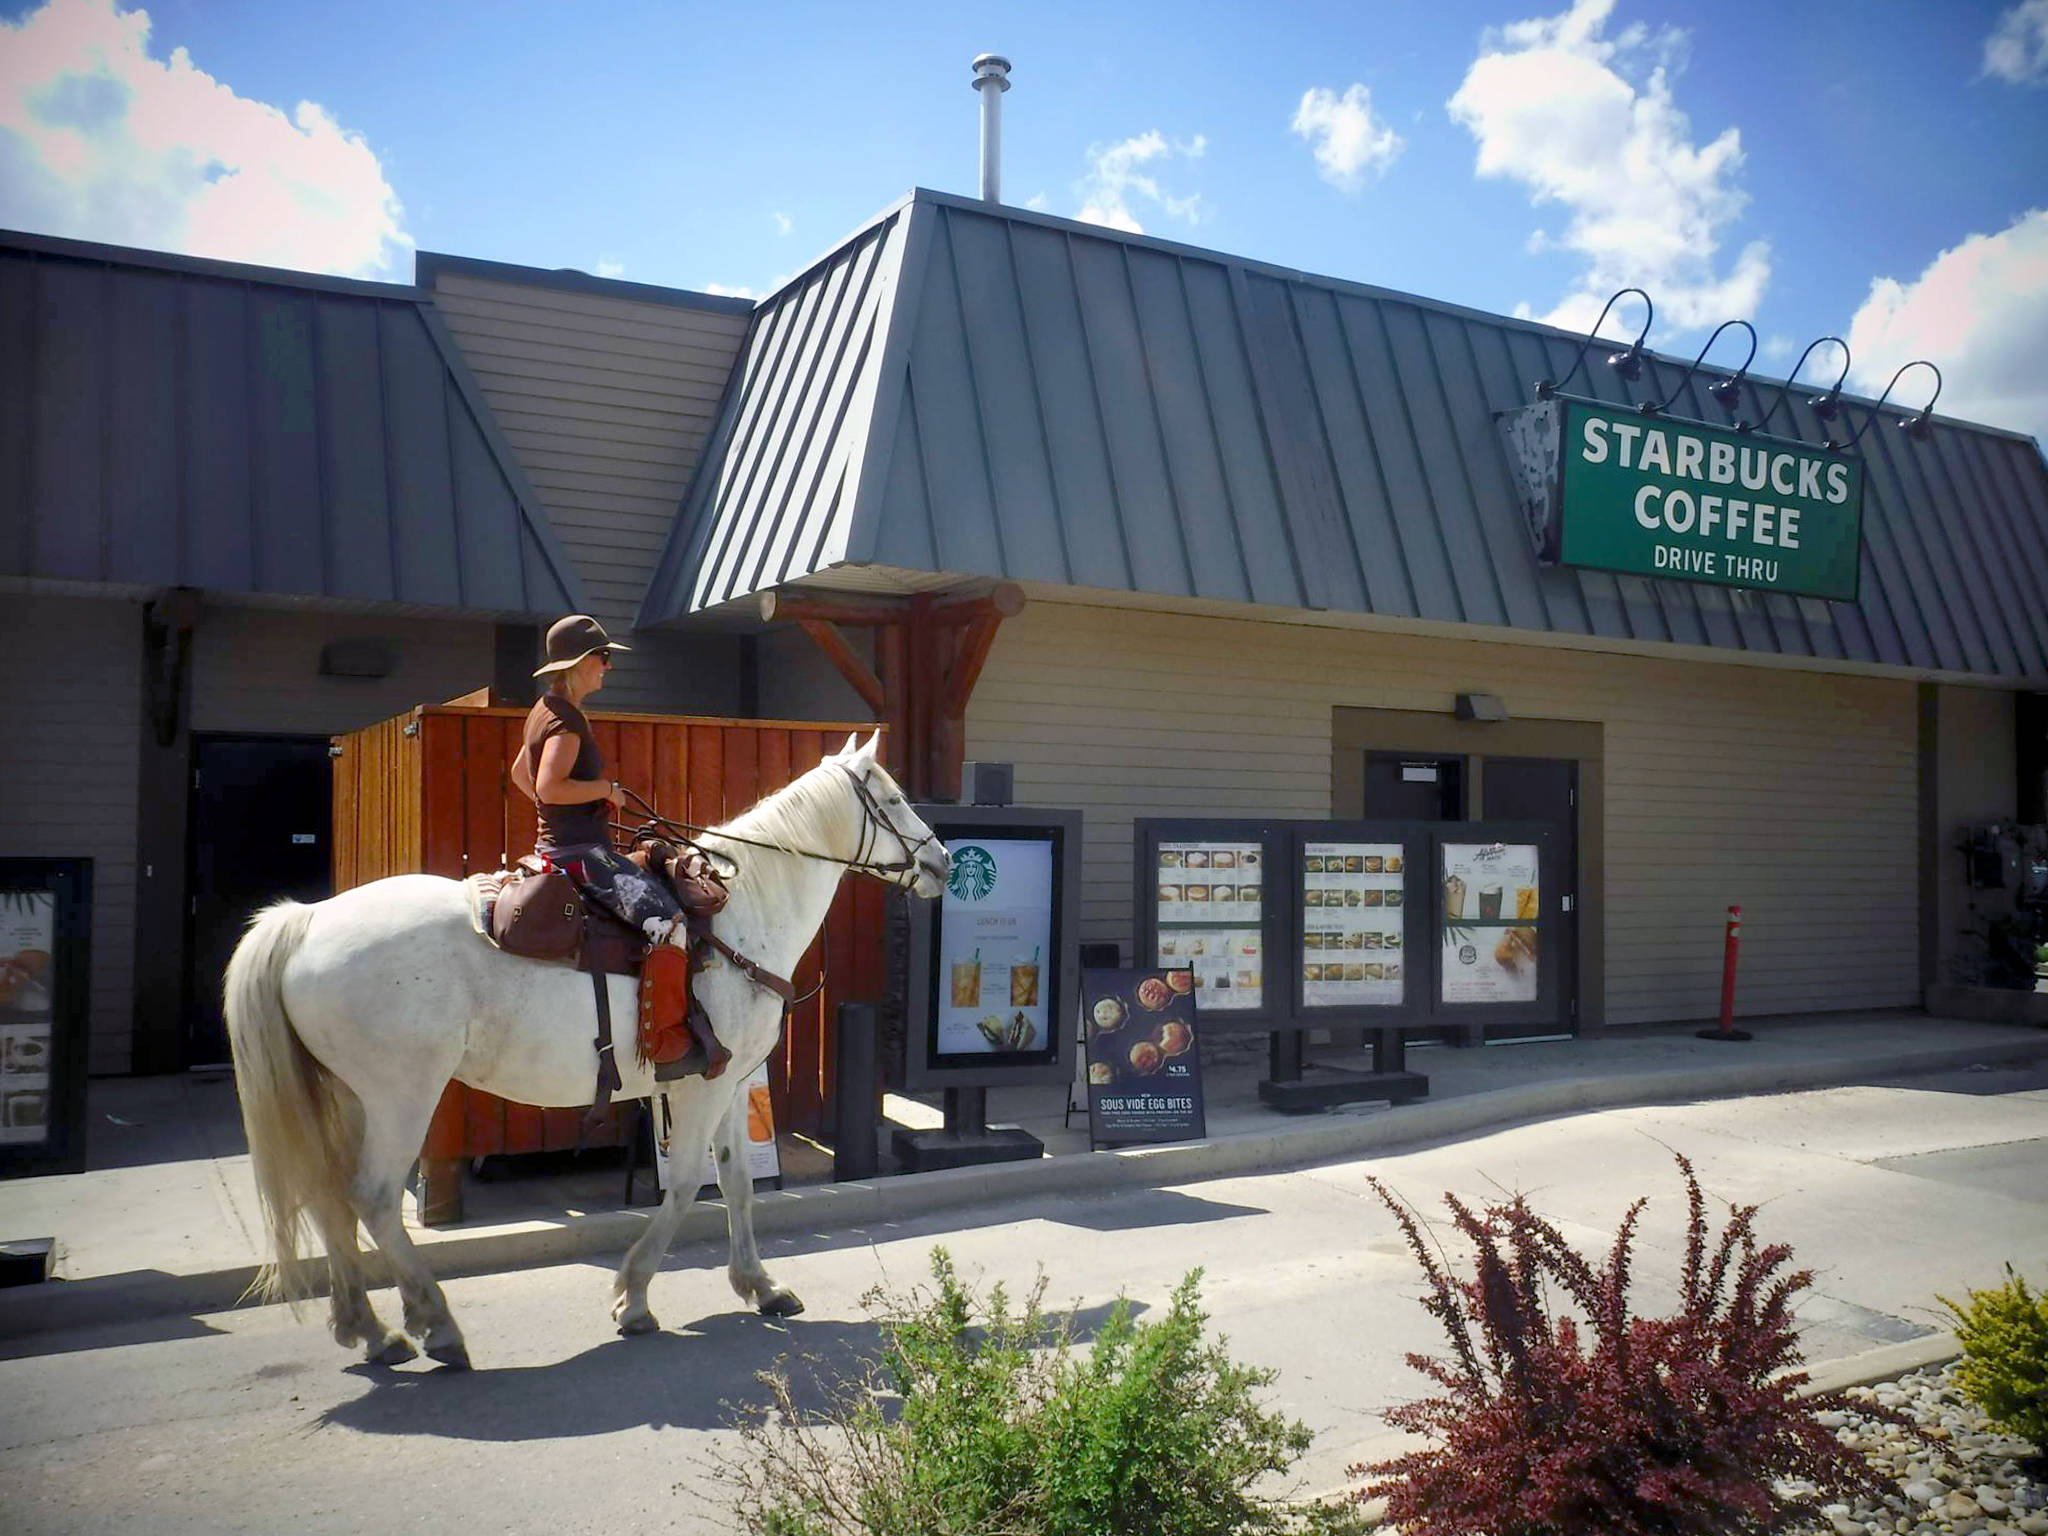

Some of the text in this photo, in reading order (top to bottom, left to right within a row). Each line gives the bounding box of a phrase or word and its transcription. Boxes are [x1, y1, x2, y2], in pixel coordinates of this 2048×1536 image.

[1582, 417, 1849, 505] STARBUCKS
[1634, 484, 1801, 550] COFFEE
[1654, 544, 1779, 583] DRIVE THRU
[1100, 1097, 1193, 1110] SOUS VIDE EGG BITES
